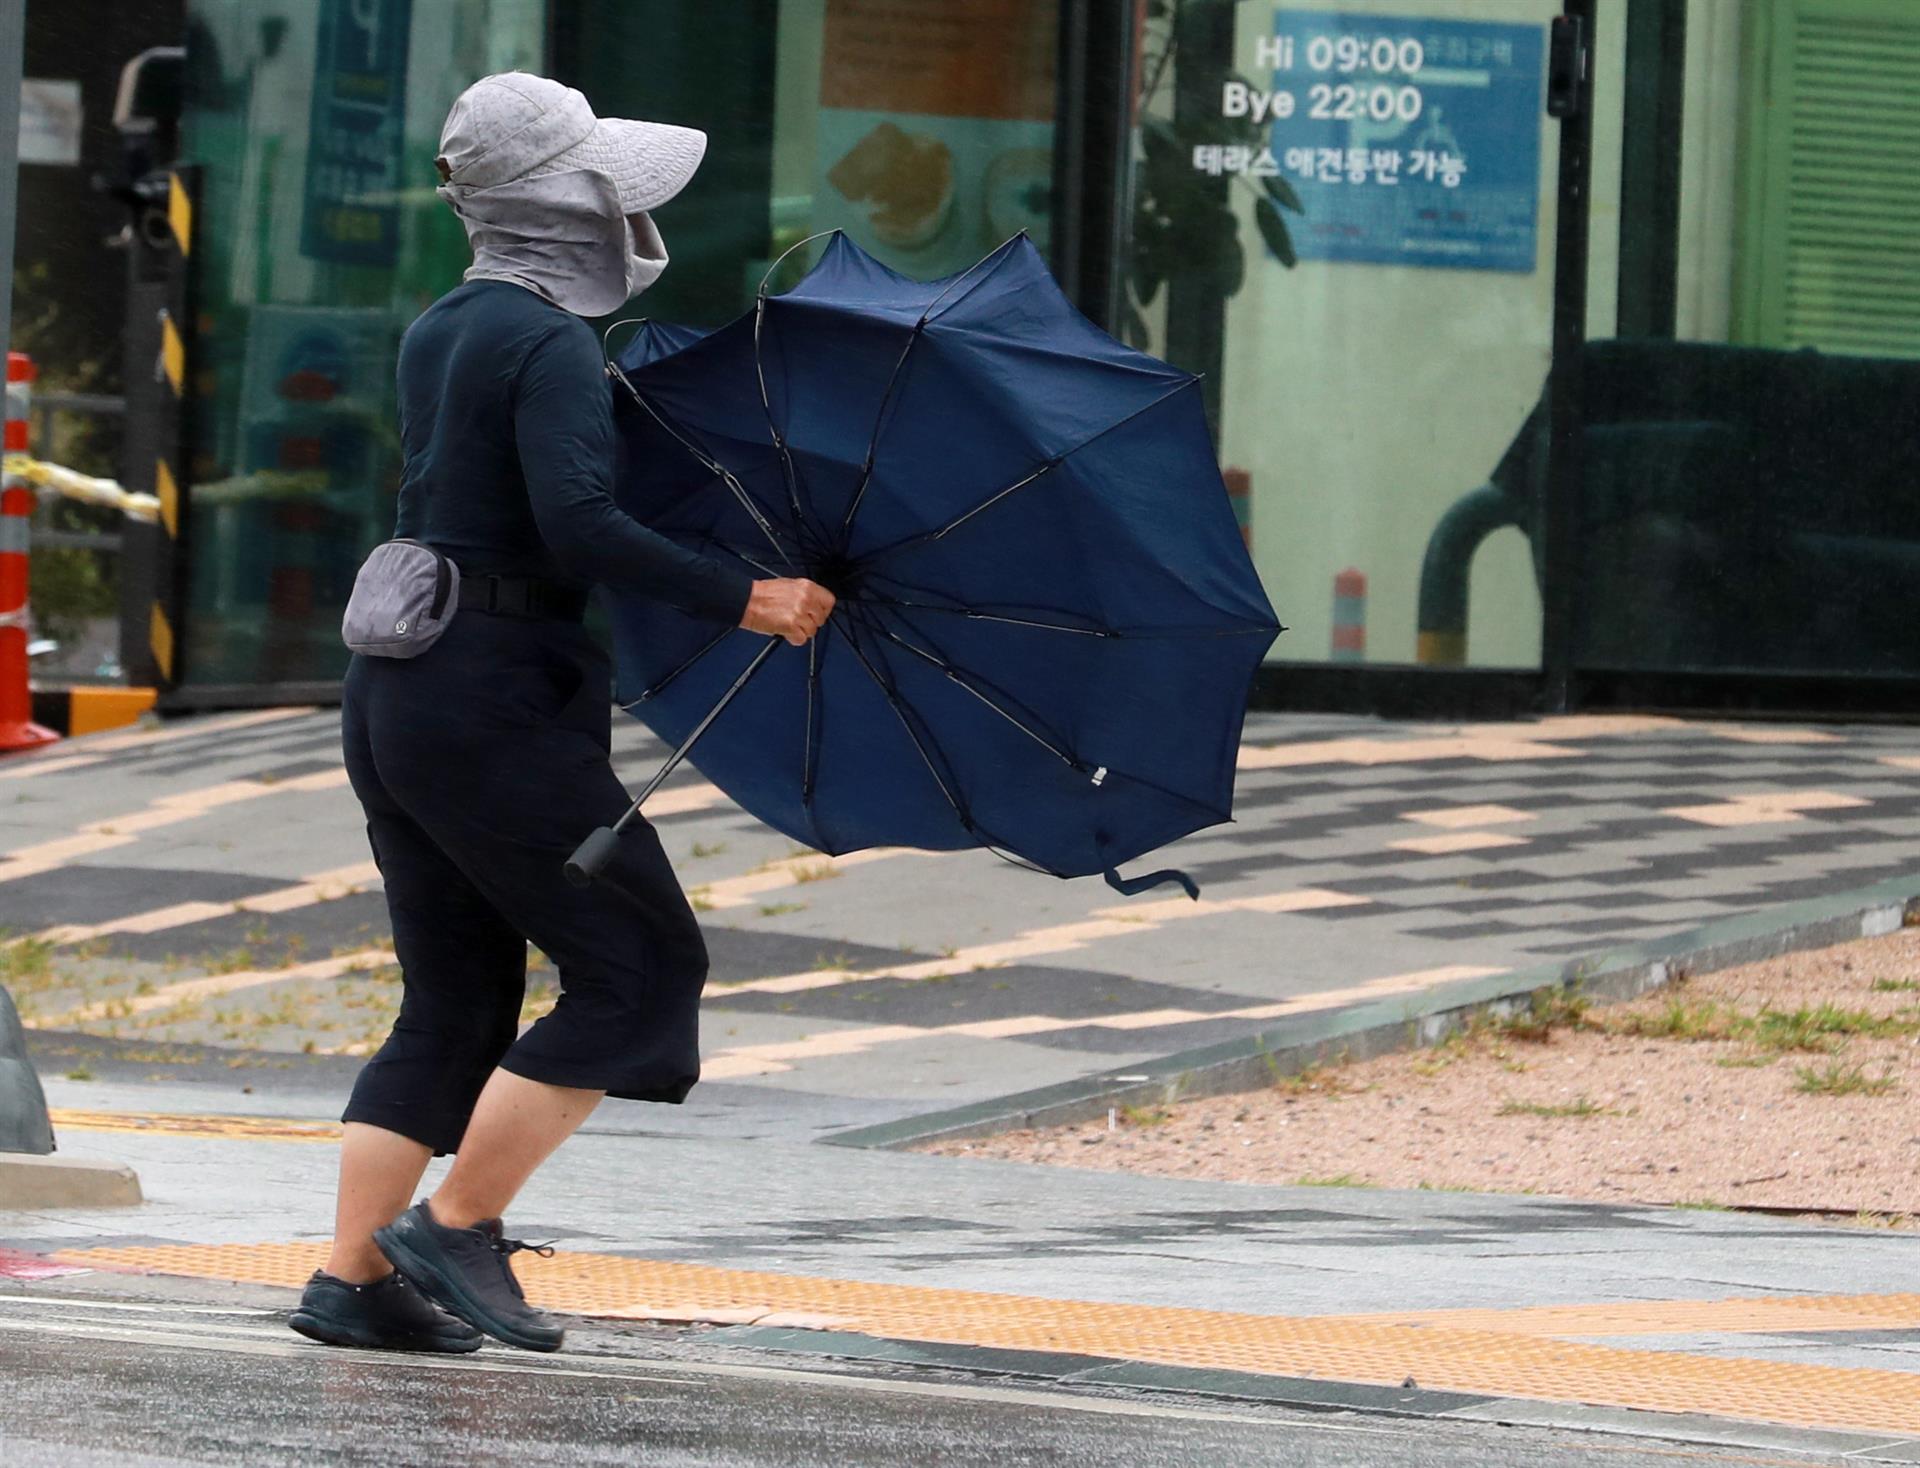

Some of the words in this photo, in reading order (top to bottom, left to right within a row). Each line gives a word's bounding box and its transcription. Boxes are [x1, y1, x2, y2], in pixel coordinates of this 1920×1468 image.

[1255, 34, 1293, 70] Hi
[1306, 36, 1424, 74] 09:00
[1222, 82, 1295, 124] Bye
[1308, 84, 1423, 122] 22:00
[1192, 144, 1280, 177] 테라스
[1285, 147, 1403, 185] 애견동반
[1407, 150, 1468, 188] 가능
